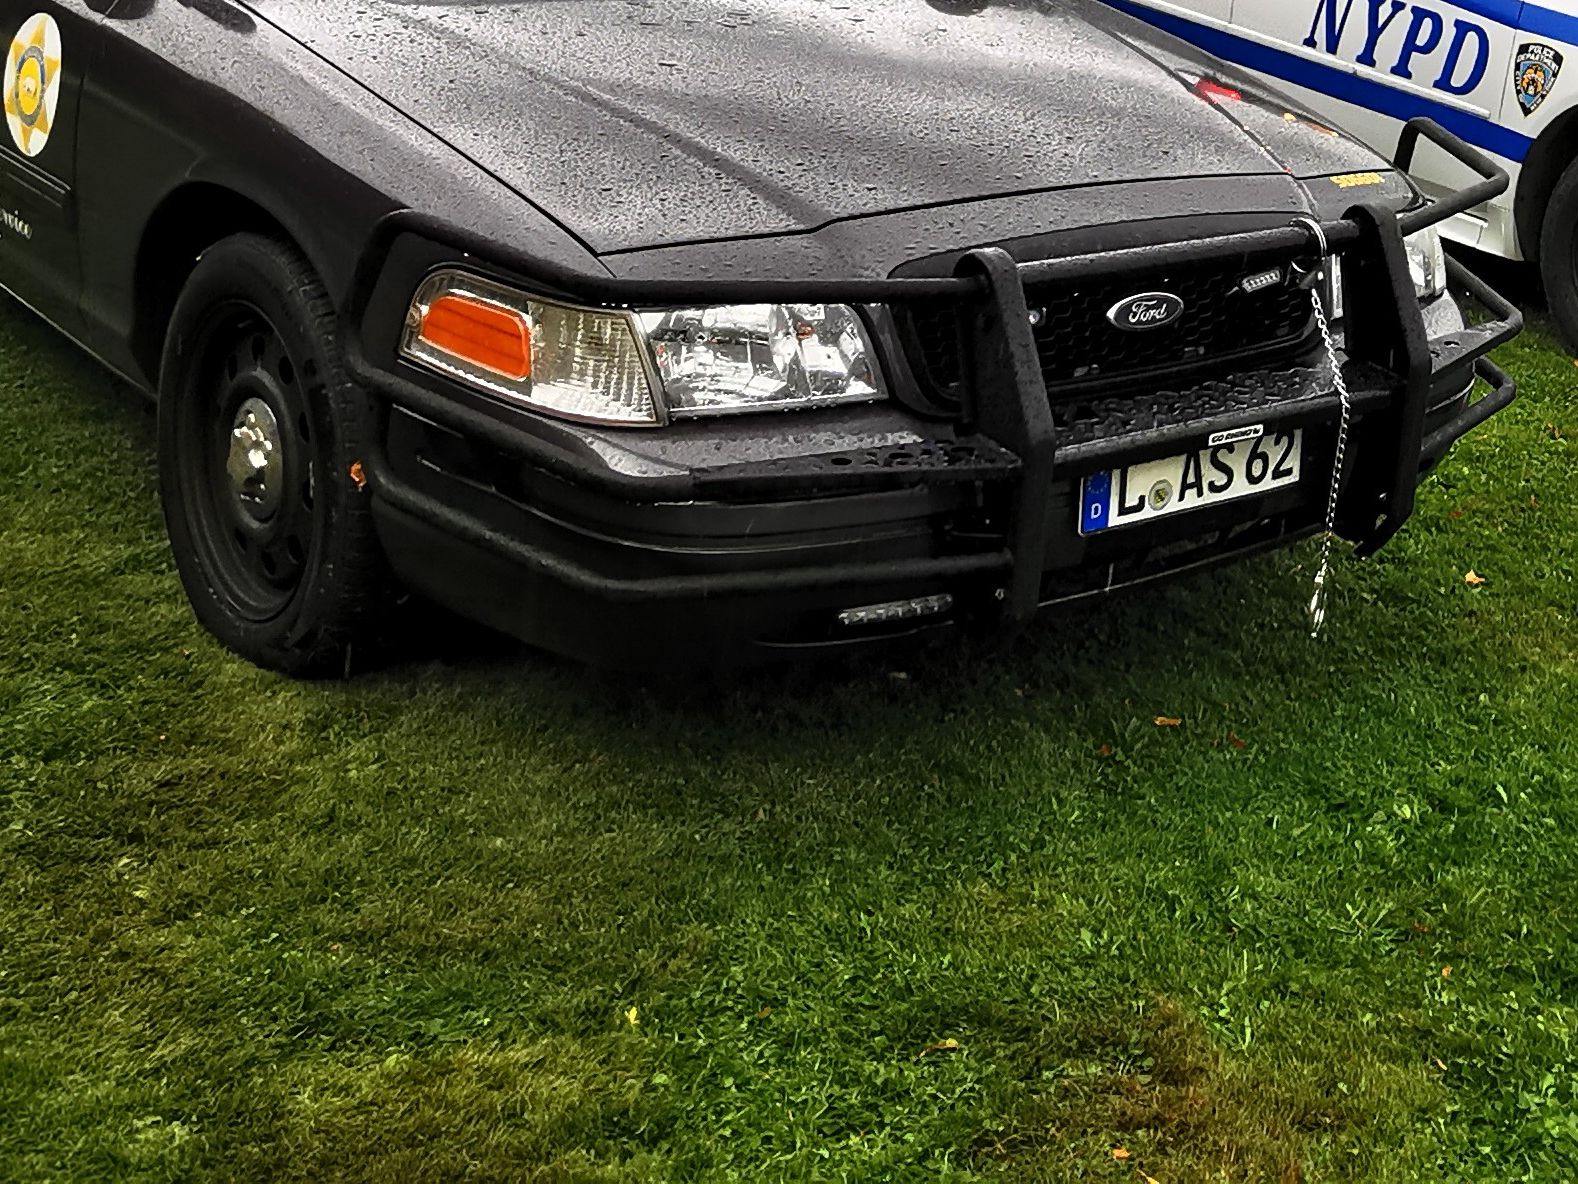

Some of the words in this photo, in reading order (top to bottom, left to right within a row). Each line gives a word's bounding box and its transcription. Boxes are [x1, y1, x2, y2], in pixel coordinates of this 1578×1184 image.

[1129, 300, 1168, 323] Ford
[1091, 503, 1102, 520] D
[1117, 466, 1146, 517] L
[1178, 442, 1235, 503] AS
[1245, 428, 1296, 486] 62
